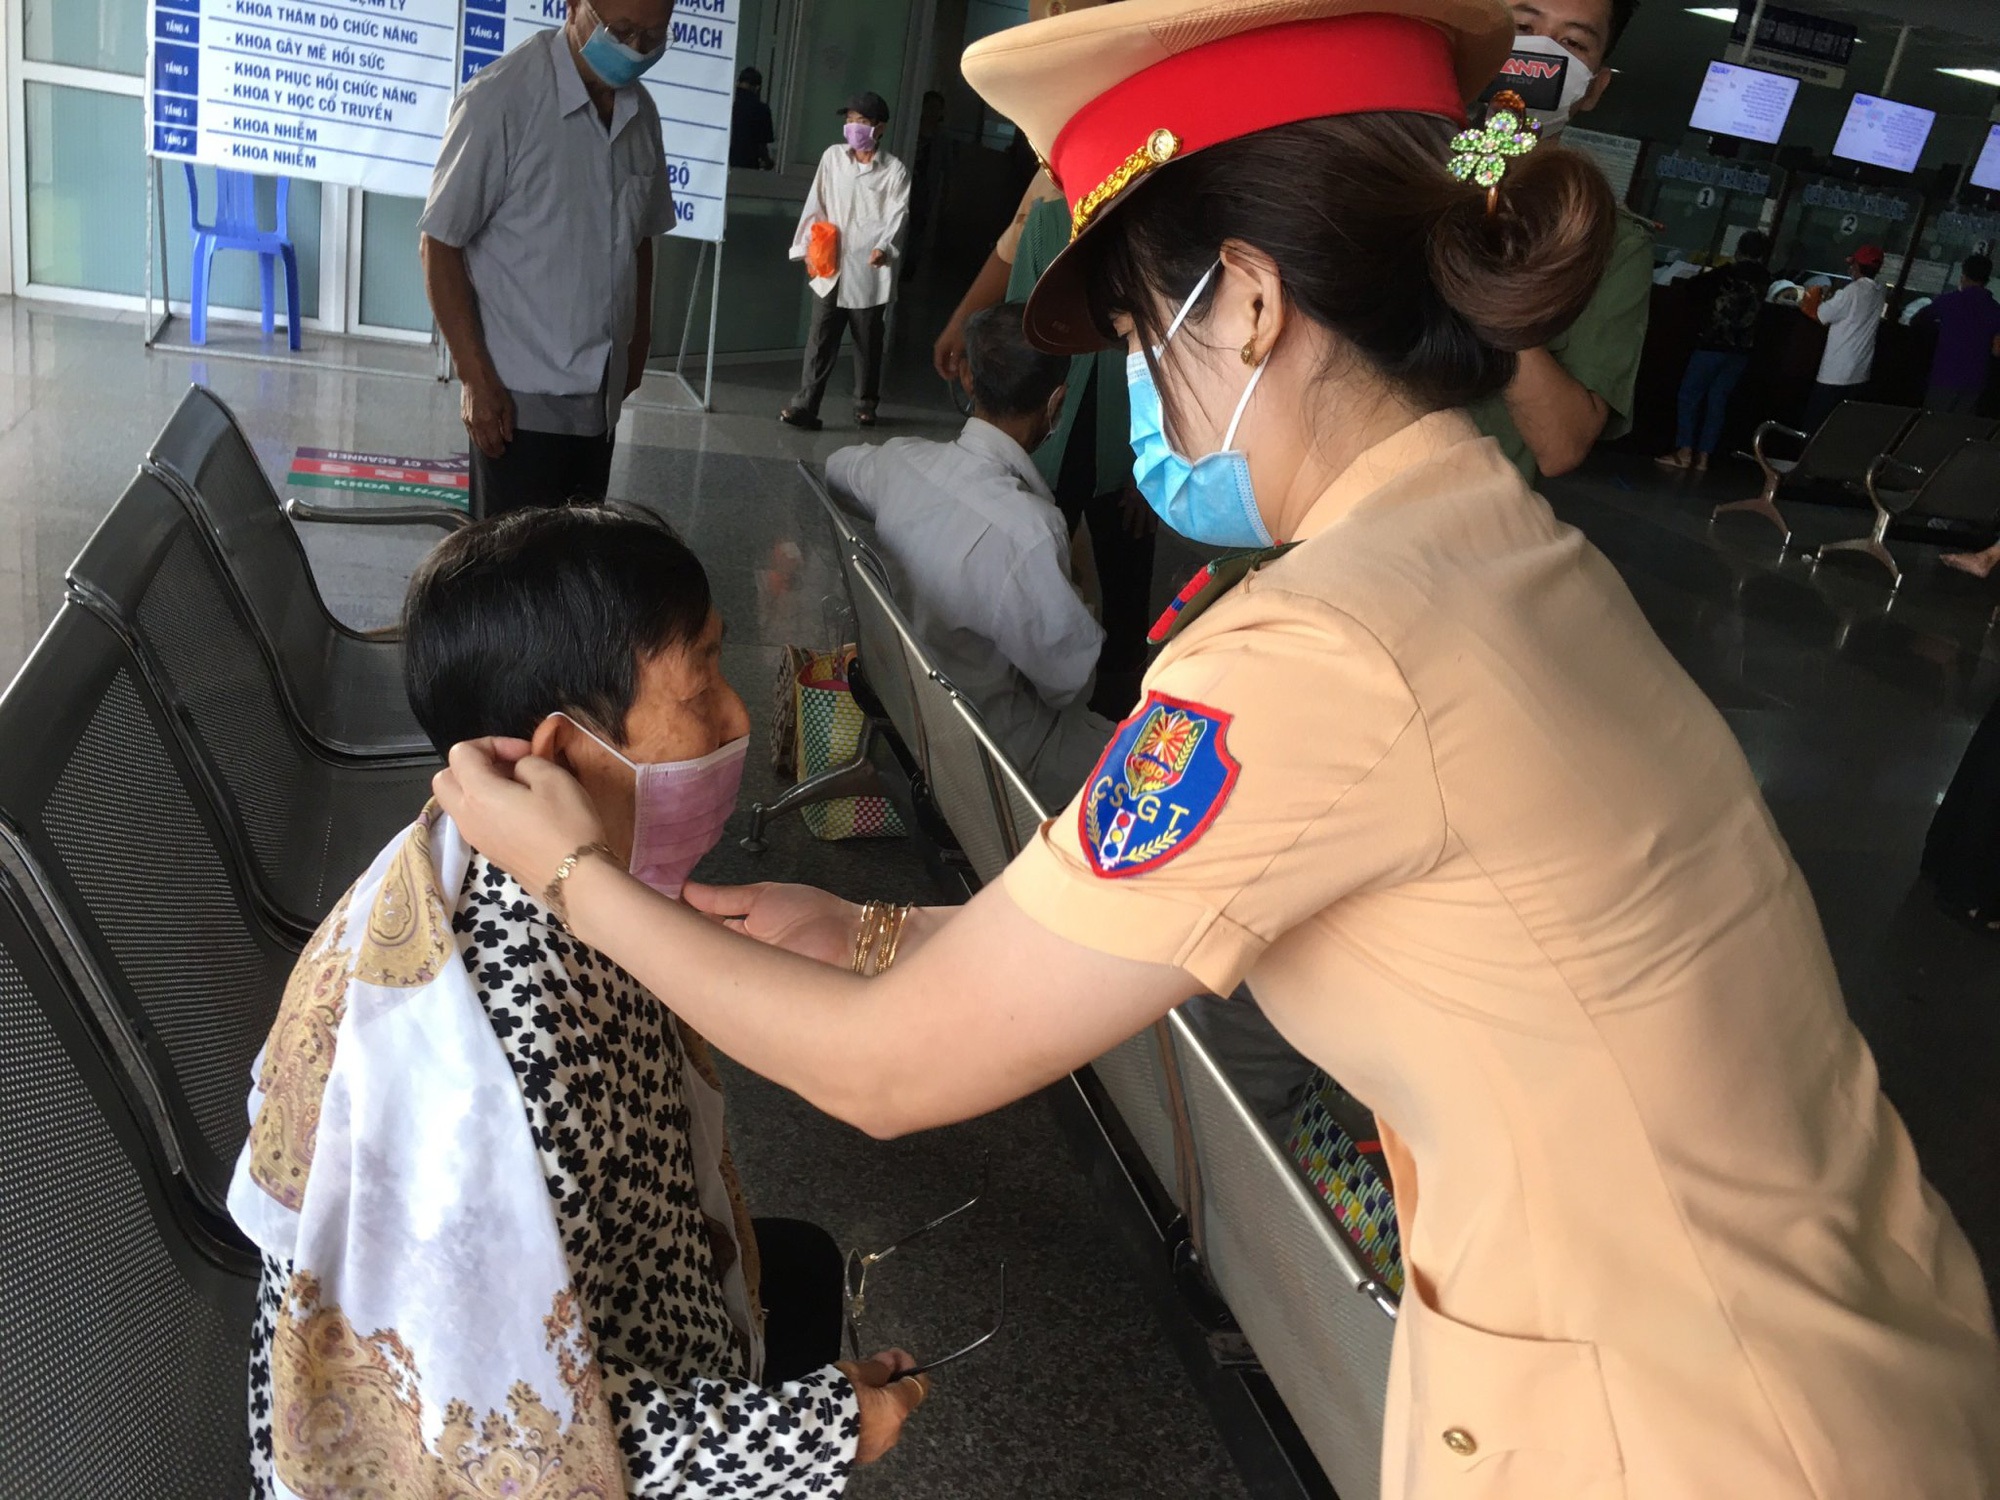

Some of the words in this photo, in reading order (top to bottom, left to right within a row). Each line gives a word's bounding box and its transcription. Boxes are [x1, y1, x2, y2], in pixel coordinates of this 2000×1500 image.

[236, 0, 273, 18] KHOA
[673, 22, 723, 49] MẠCH
[235, 32, 272, 51] KHOA
[276, 37, 303, 56] GÂY
[307, 43, 327, 60] MÊ
[359, 52, 385, 71] SỨC
[1500, 58, 1561, 79] ANTV
[234, 61, 271, 80] KHOA
[276, 68, 311, 87] PHỤC
[343, 79, 378, 98] CHỨC
[233, 83, 270, 102] KHOA
[275, 90, 283, 104] Y
[287, 92, 314, 110] HỌC
[233, 116, 269, 135] KHOA
[232, 143, 269, 161] KHOA
[1701, 189, 1710, 206] 1
[1843, 216, 1855, 232] 2
[327, 452, 396, 465] SCANNER
[334, 479, 391, 490] KHOA
